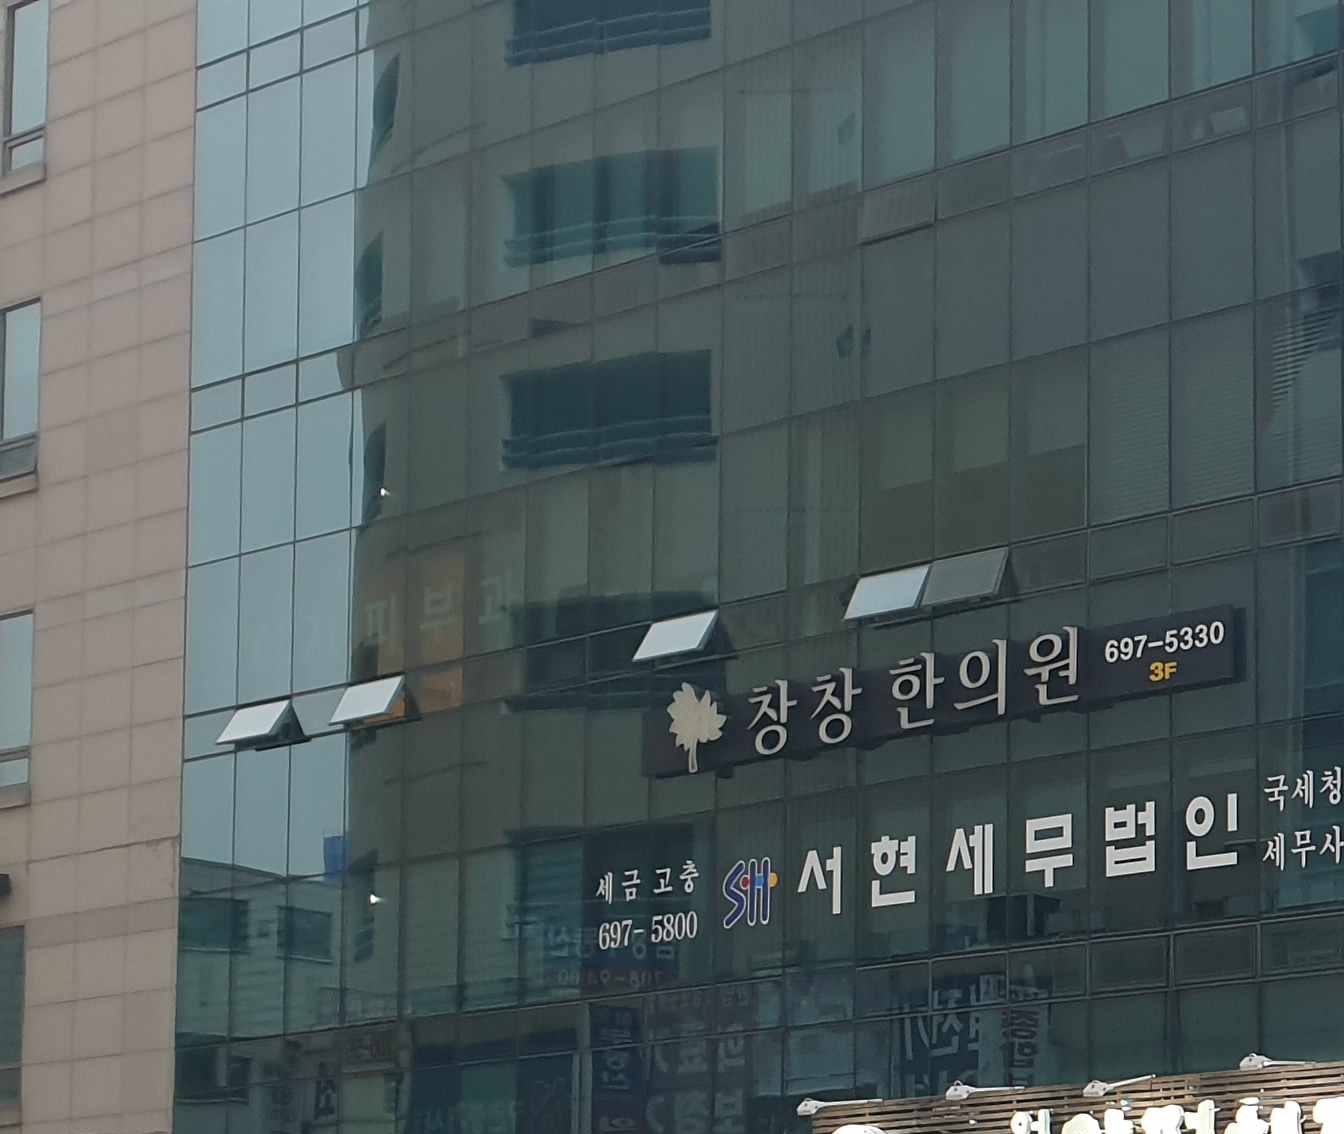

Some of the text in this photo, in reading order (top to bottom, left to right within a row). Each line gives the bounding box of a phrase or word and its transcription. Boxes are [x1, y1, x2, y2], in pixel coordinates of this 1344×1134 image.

[1104, 621, 1225, 664] 697-5330
[747, 625, 1079, 756] 창창 한의원
[1148, 660, 1177, 683] 3F
[1264, 766, 1342, 812] 국세청
[797, 793, 1240, 916] 서현세무법인
[595, 860, 700, 905] 세금 고충
